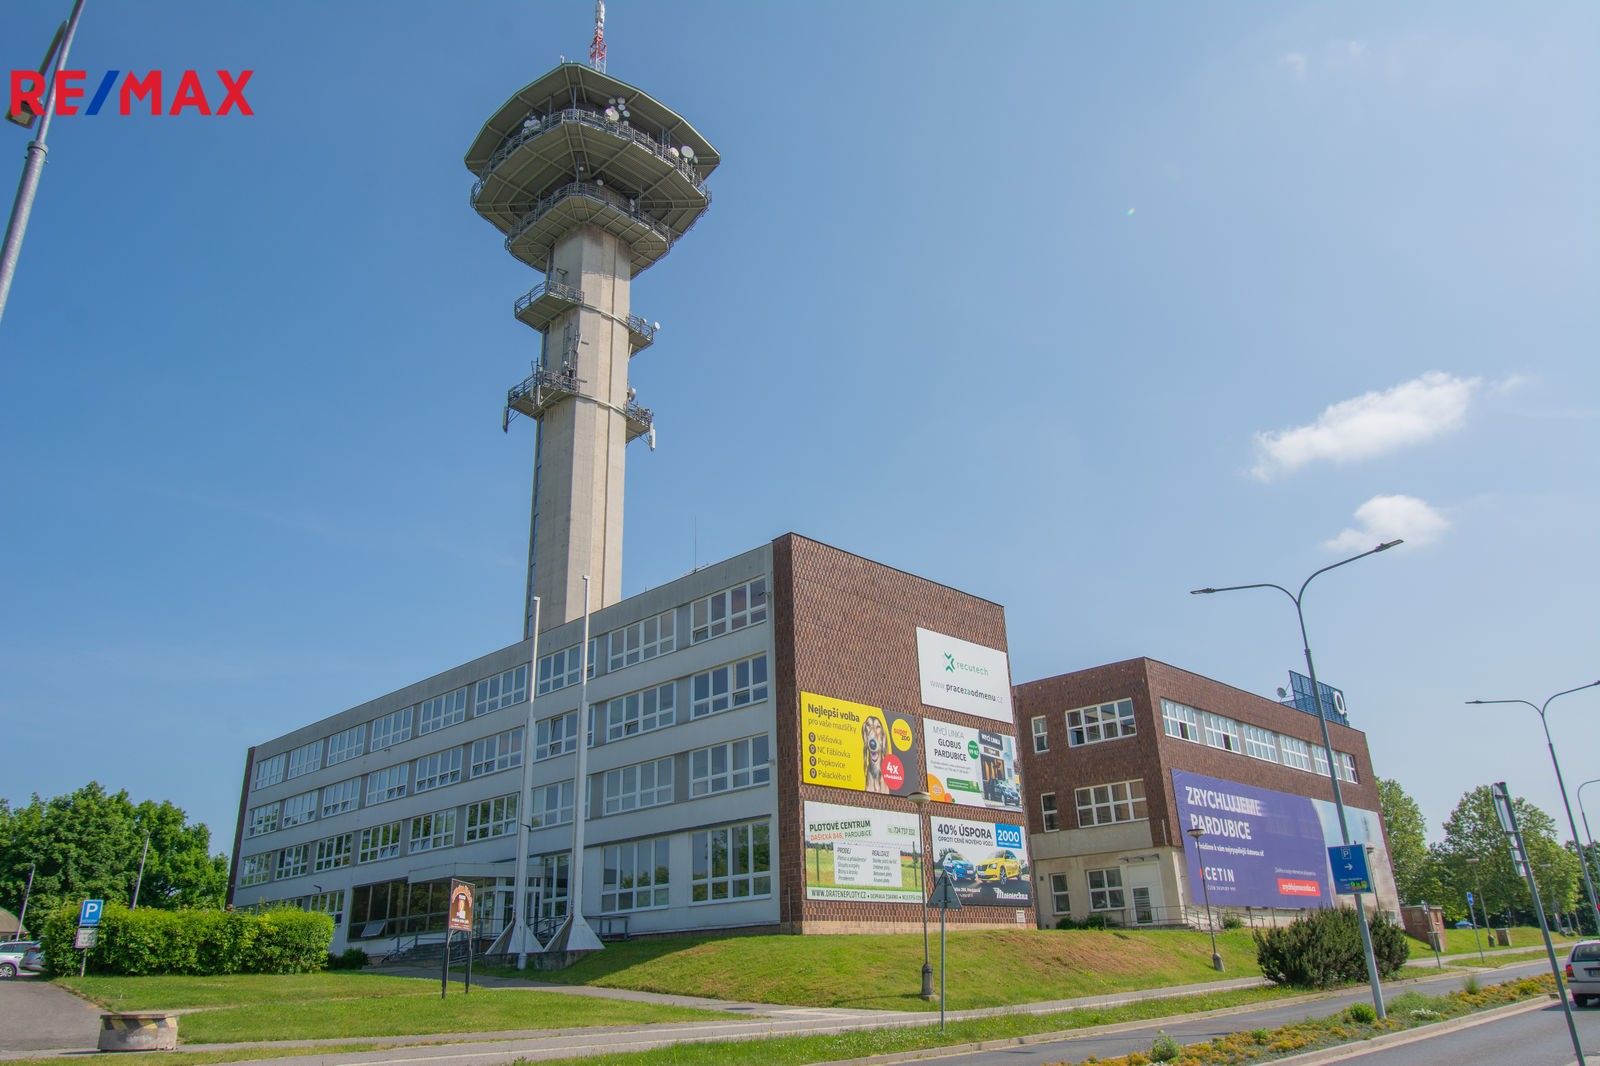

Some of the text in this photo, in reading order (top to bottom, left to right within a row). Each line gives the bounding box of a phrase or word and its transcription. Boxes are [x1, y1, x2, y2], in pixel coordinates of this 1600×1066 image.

[957, 662, 989, 676] recutech
[930, 680, 1004, 704] www.pracezaodmenu.cz
[808, 703, 860, 722] Nejlepší volba
[808, 718, 857, 734] pro vaše mazlíčky
[938, 738, 961, 749] GLOBUS
[934, 749, 967, 761] PARDUBICE
[886, 761, 899, 774] 4x
[1185, 786, 1263, 816] ZRYCHLUJEME
[840, 820, 871, 830] CENTRUM
[937, 824, 992, 839] 40% ÚSPORA
[1190, 813, 1252, 840] PARDUBICE
[845, 830, 871, 838] PARDUBICE
[997, 830, 1020, 842] 2000
[1205, 866, 1235, 882] CETIN
[811, 889, 866, 899] WWW.DRATENEPLOTY.CZ
[85, 903, 98, 918] P
